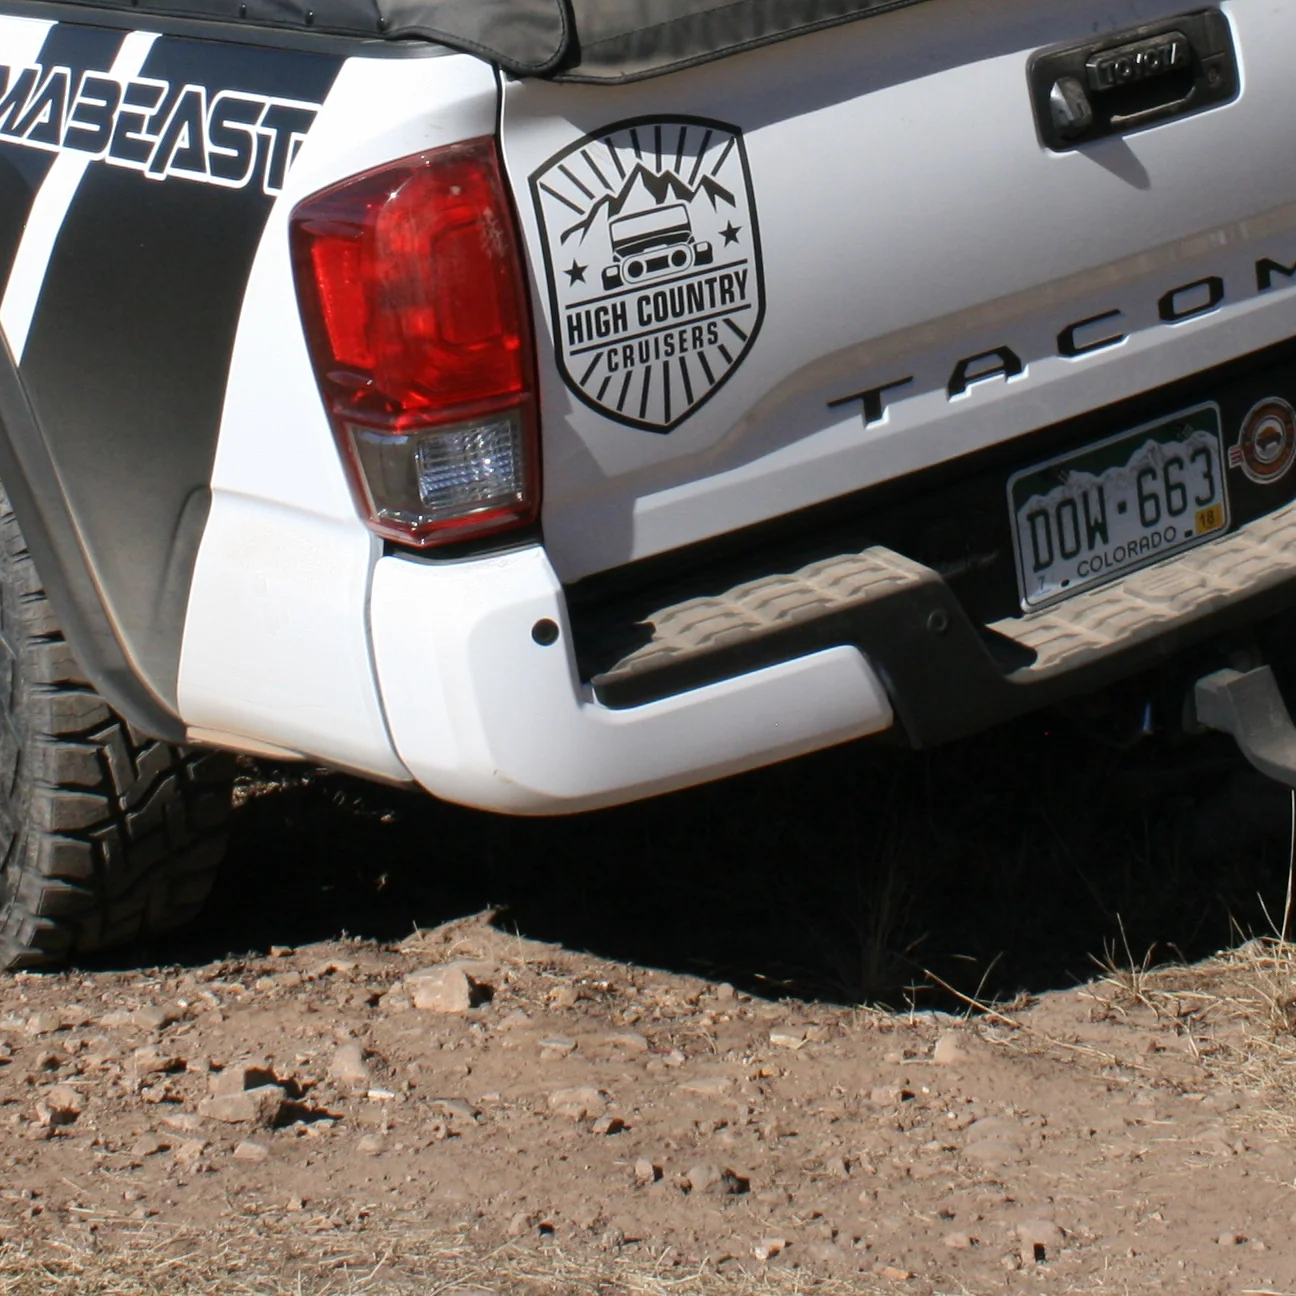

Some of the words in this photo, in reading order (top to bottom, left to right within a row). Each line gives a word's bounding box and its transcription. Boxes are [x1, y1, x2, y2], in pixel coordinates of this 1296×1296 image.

[565, 300, 628, 346] HIGH
[637, 267, 749, 327] COUNTRY
[607, 320, 719, 373] CRUISERS
[1198, 508, 1216, 529] 18
[1076, 525, 1177, 578] COLORADO
